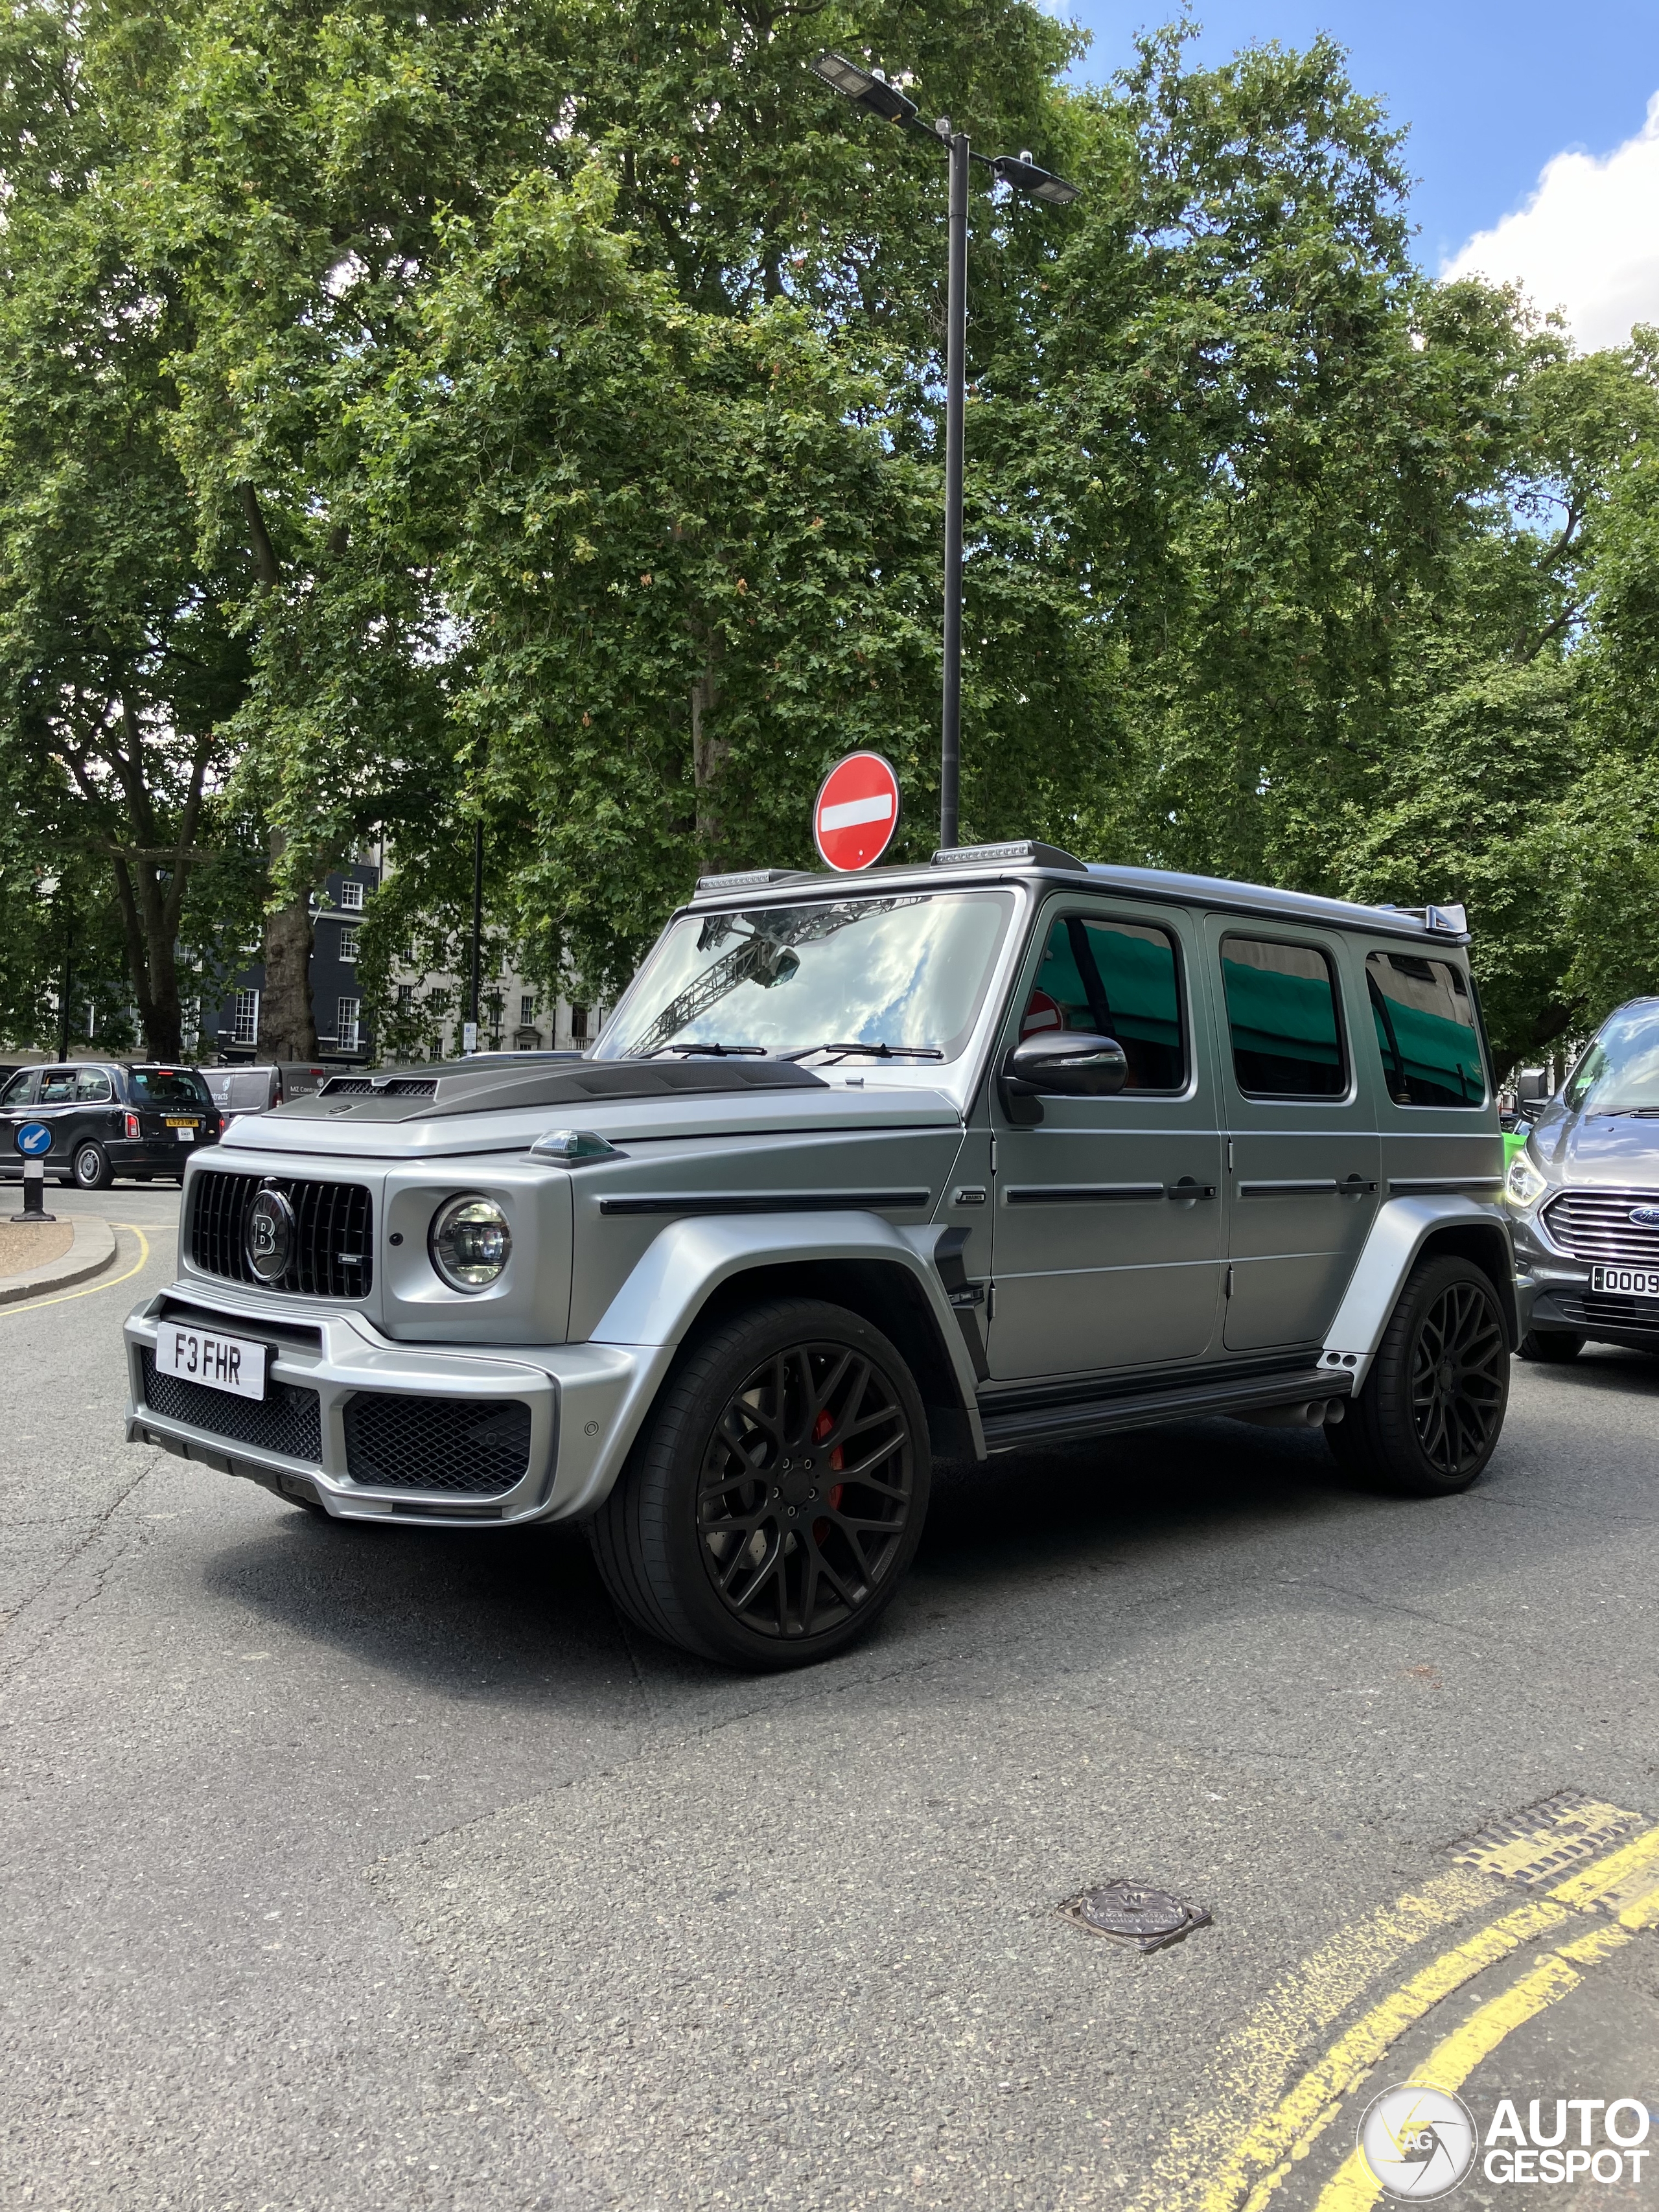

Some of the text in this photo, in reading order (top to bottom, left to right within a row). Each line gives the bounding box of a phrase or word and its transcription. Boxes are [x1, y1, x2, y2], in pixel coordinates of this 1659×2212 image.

[254, 1214, 275, 1255] B
[1640, 1209, 1659, 1222] For
[175, 1333, 241, 1386] F3 FHR
